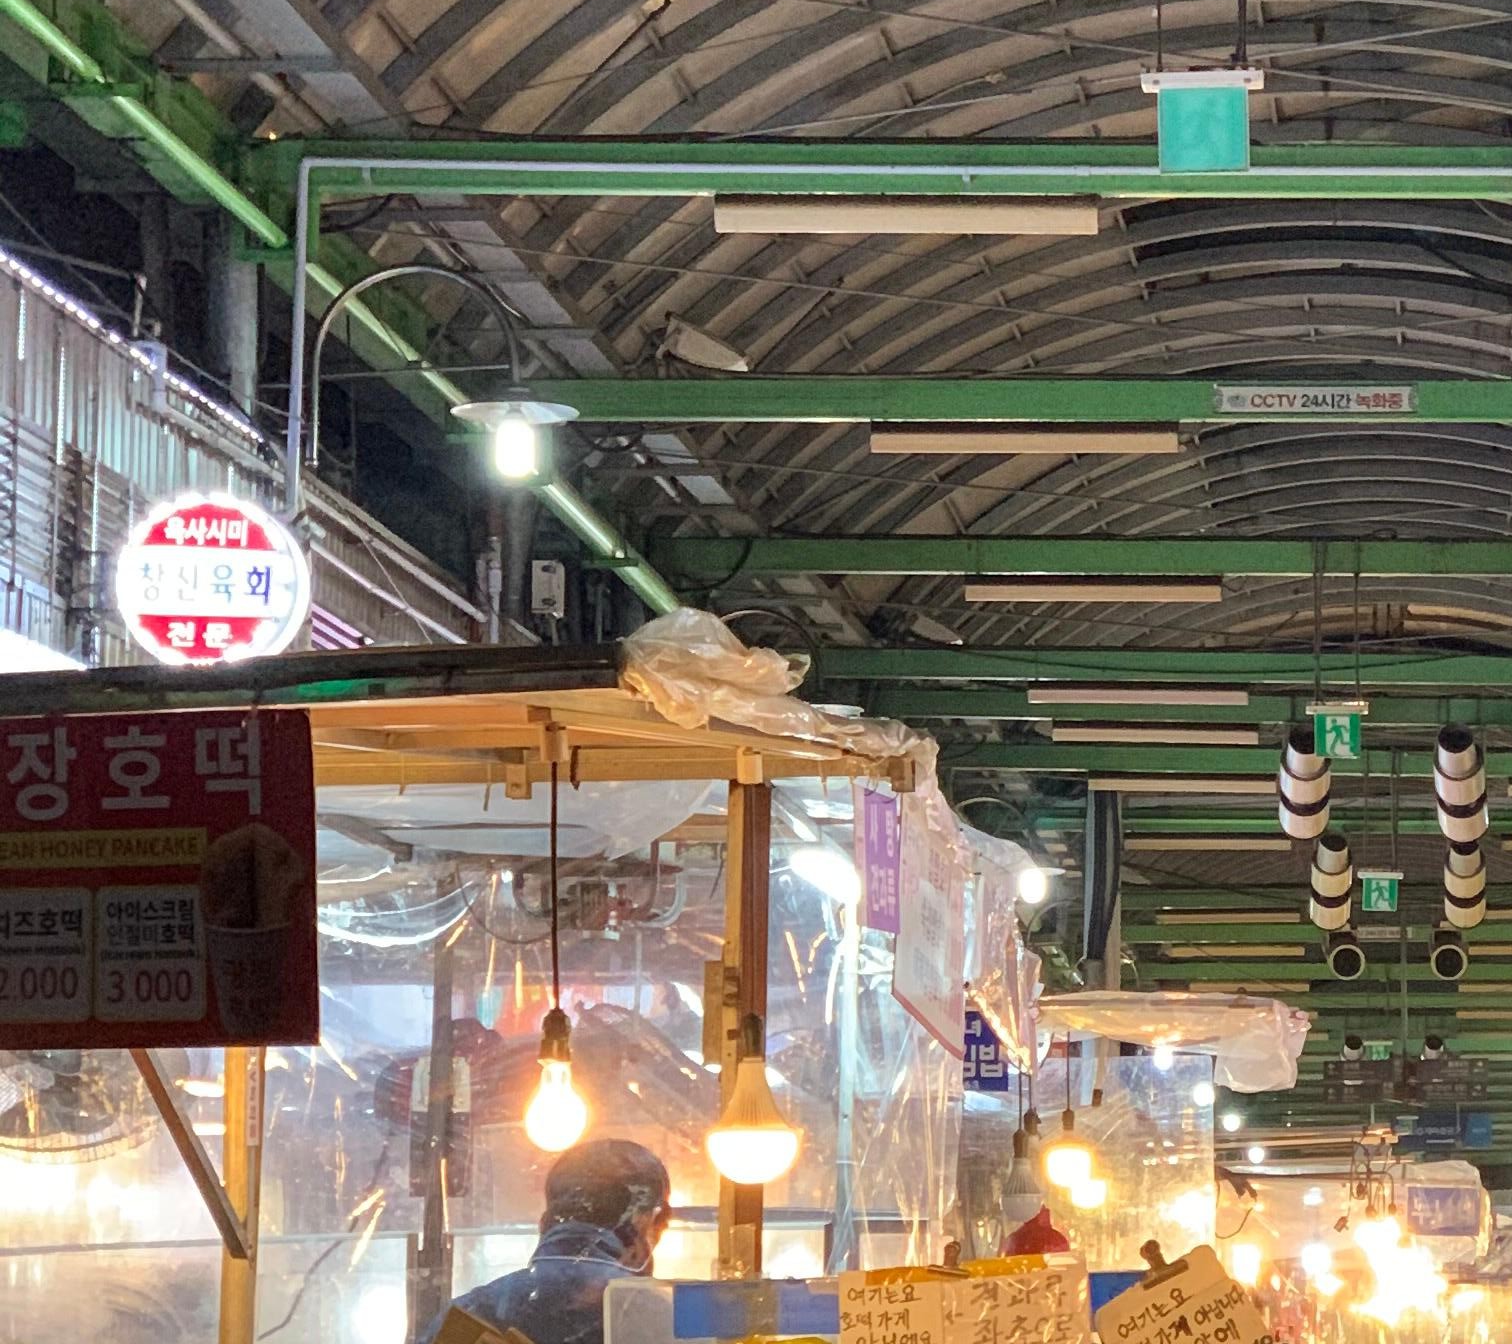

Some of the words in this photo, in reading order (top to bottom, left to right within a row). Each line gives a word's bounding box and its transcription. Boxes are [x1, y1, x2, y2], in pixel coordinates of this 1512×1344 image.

[1250, 393, 1297, 408] CCTV
[1300, 393, 1351, 409] 24시간
[1355, 392, 1404, 409] 녹화중
[164, 517, 249, 547] 육사시미
[167, 621, 233, 648] 전문
[41, 839, 108, 858] HONEY
[111, 836, 198, 856] PANCAKE
[106, 900, 195, 923] 아이스크림
[161, 923, 195, 946] 호떡
[847, 1285, 922, 1304] 여기는요
[1193, 1285, 1245, 1325] 아닙니다
[877, 1308, 911, 1332] 가게
[1117, 1288, 1194, 1339] 여기는요
